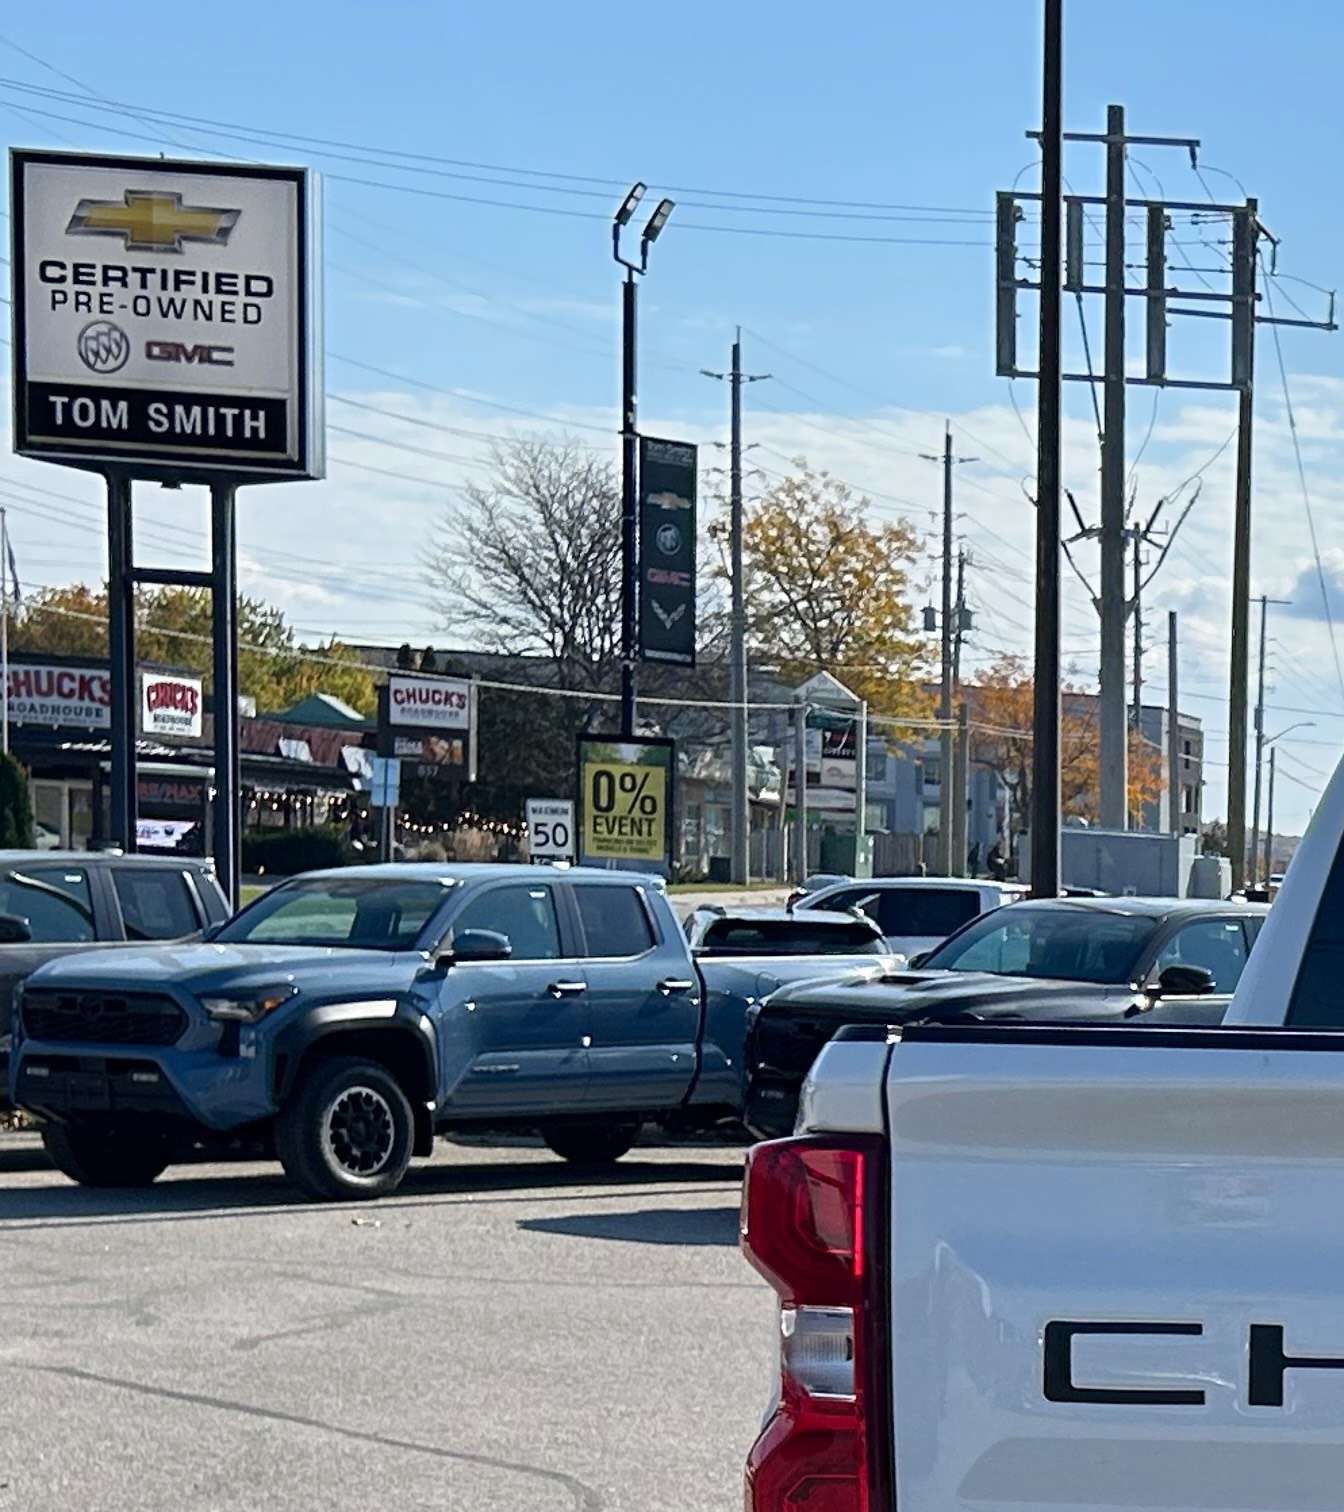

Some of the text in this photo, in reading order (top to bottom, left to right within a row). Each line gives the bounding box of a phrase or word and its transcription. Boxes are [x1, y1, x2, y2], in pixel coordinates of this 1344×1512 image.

[39, 260, 274, 298] CERTIFIED
[50, 289, 262, 325] PRE-OWNED
[145, 340, 234, 367] GMC
[49, 395, 266, 440] TOM SMITH
[592, 769, 657, 816] 0%
[534, 822, 569, 848] 50
[592, 815, 656, 838] EVENT
